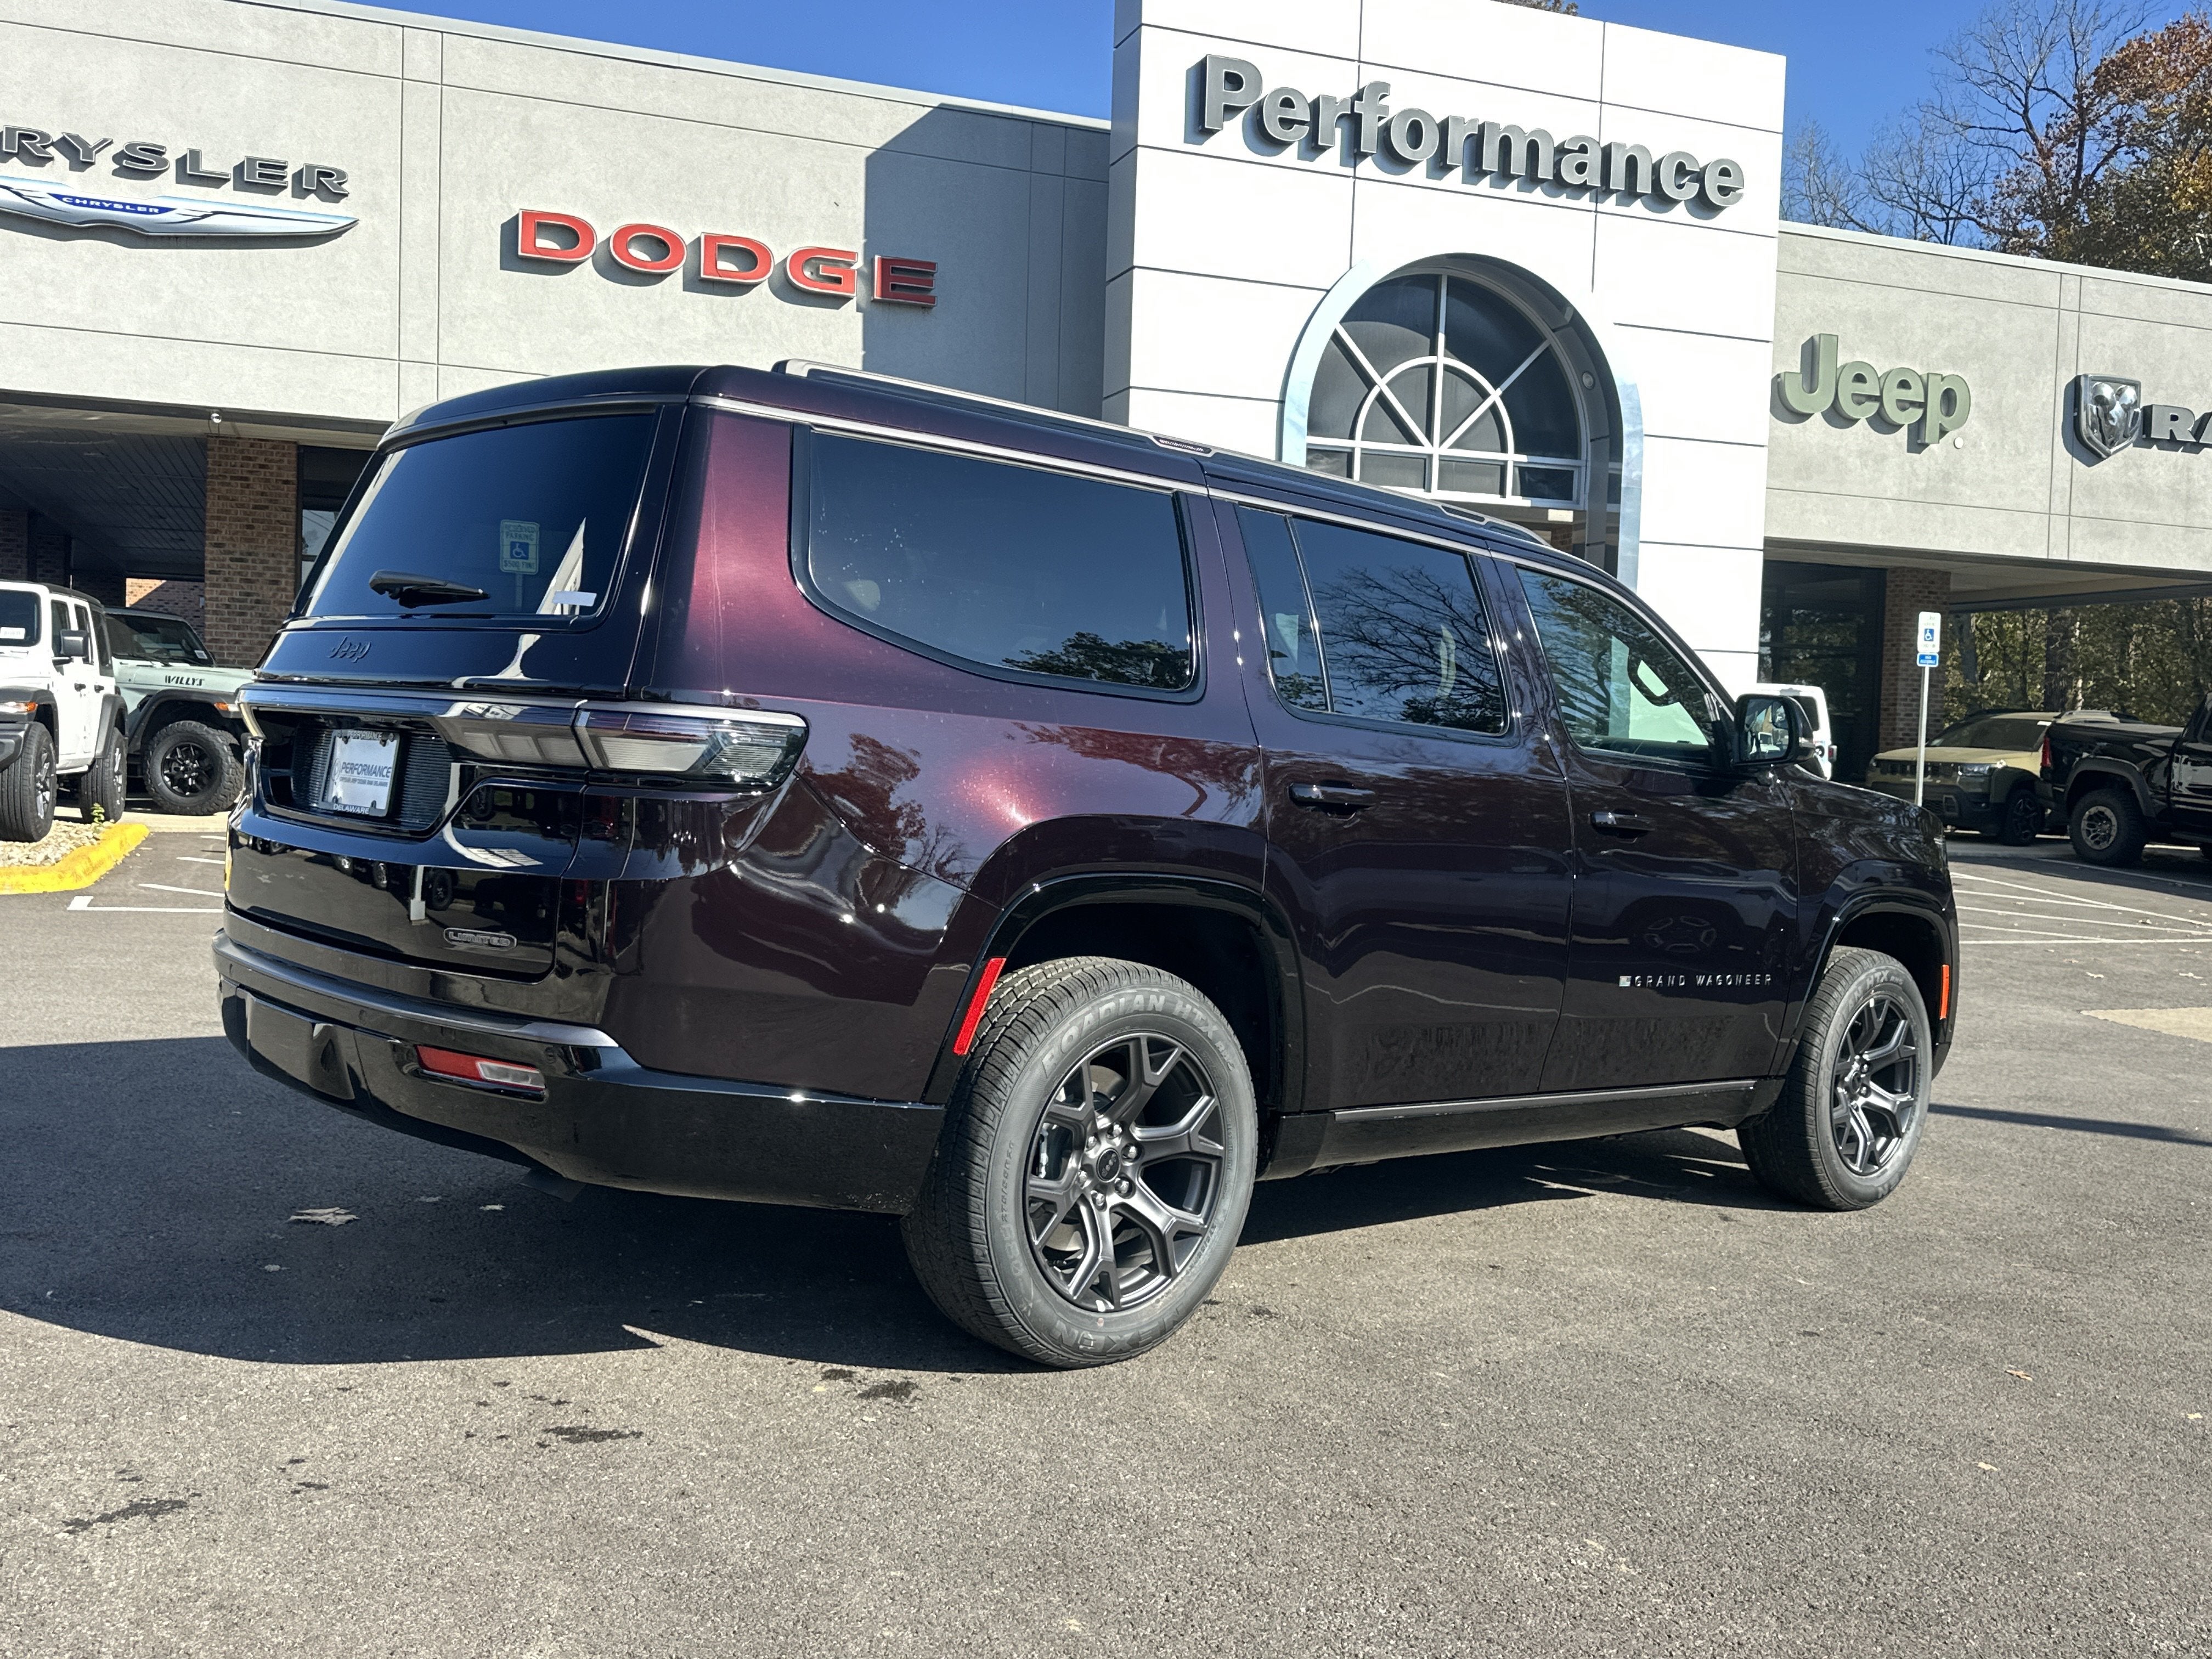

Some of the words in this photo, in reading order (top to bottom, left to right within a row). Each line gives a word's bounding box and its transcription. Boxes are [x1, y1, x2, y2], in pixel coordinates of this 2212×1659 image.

[1203, 54, 1745, 207] Performance
[61, 197, 159, 213] CHRYSLER
[517, 208, 938, 308] DODGE
[1780, 332, 1972, 445] Jeep
[505, 531, 535, 541] PARKING
[328, 635, 372, 663] Jeep
[348, 730, 383, 739] PERFORMANCE
[340, 761, 392, 778] PERFORMANCE
[333, 803, 370, 815] DELAWARE
[448, 931, 511, 946] LIMITED
[1634, 975, 1686, 987] GRAND
[1696, 974, 1771, 986] WAGONEER
[1042, 994, 1165, 1079] ROADIAN
[1173, 1000, 1218, 1041] HTX
